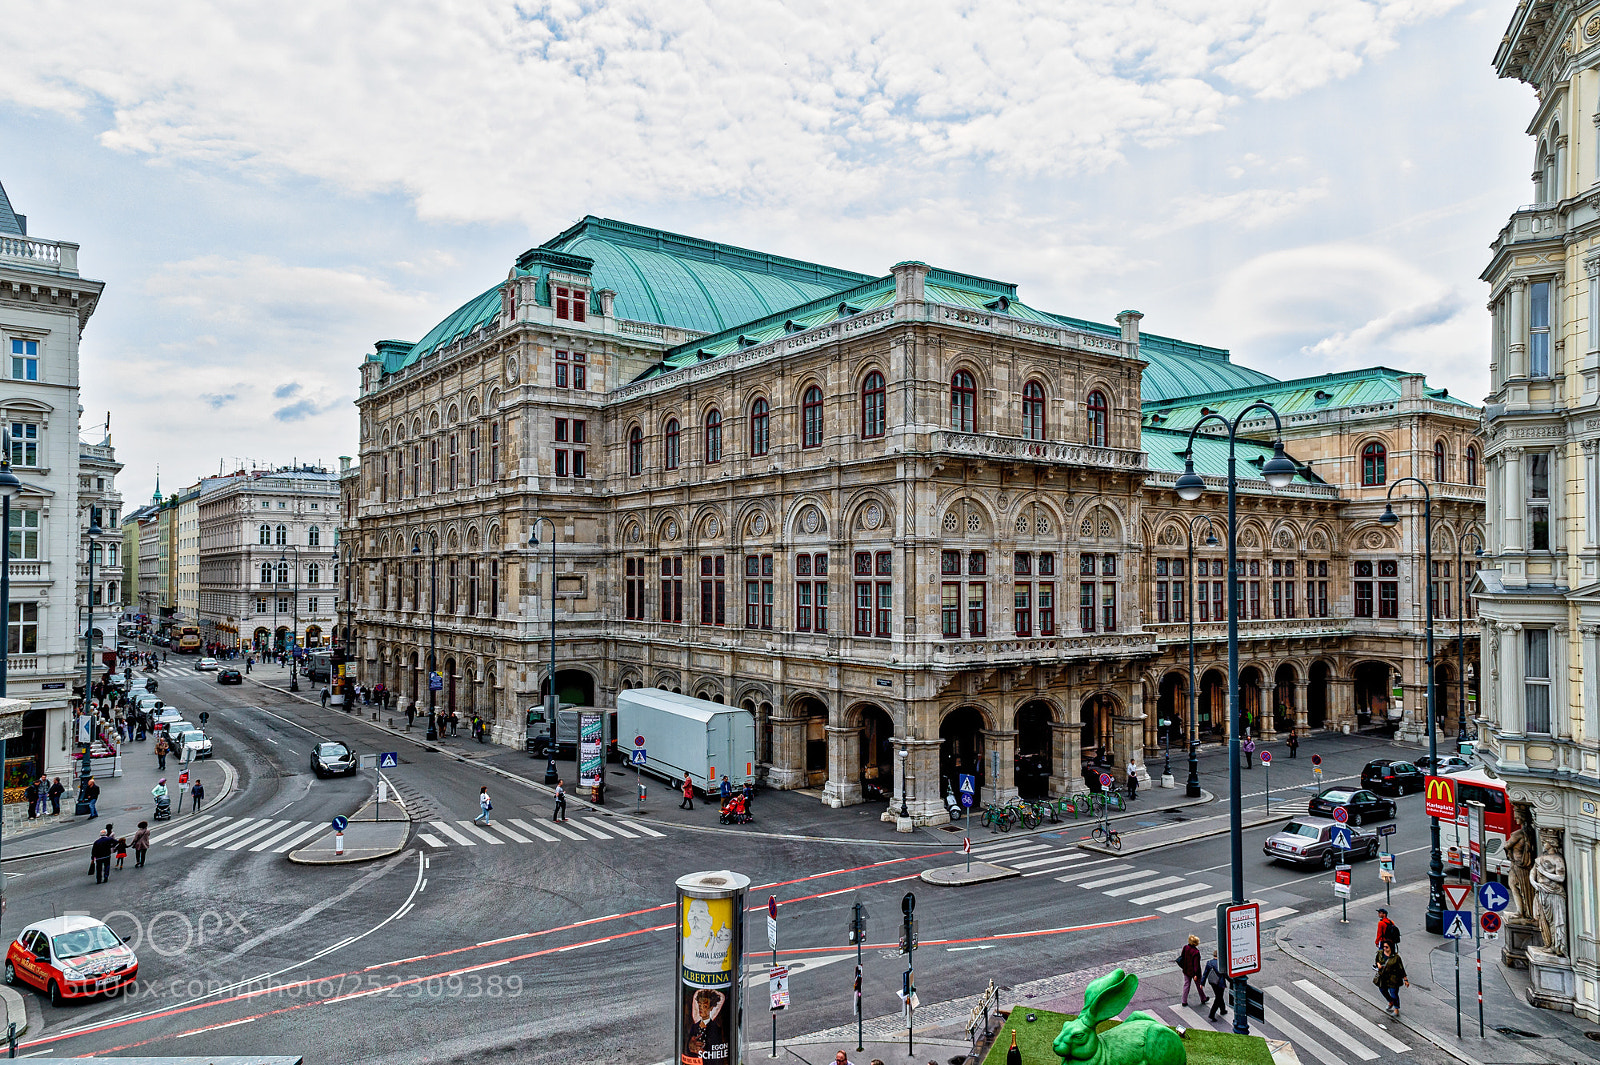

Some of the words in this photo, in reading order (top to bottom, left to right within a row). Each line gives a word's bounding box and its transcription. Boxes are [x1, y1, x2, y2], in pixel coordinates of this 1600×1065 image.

[1426, 802, 1454, 811] Karlsplatz
[1232, 921, 1255, 930] KASSEN
[695, 951, 709, 959] MARIA
[1233, 954, 1256, 966] TICKETS
[683, 969, 729, 983] ALBERTINA
[711, 1043, 728, 1051] EGON
[698, 1049, 728, 1060] SCHIELE
